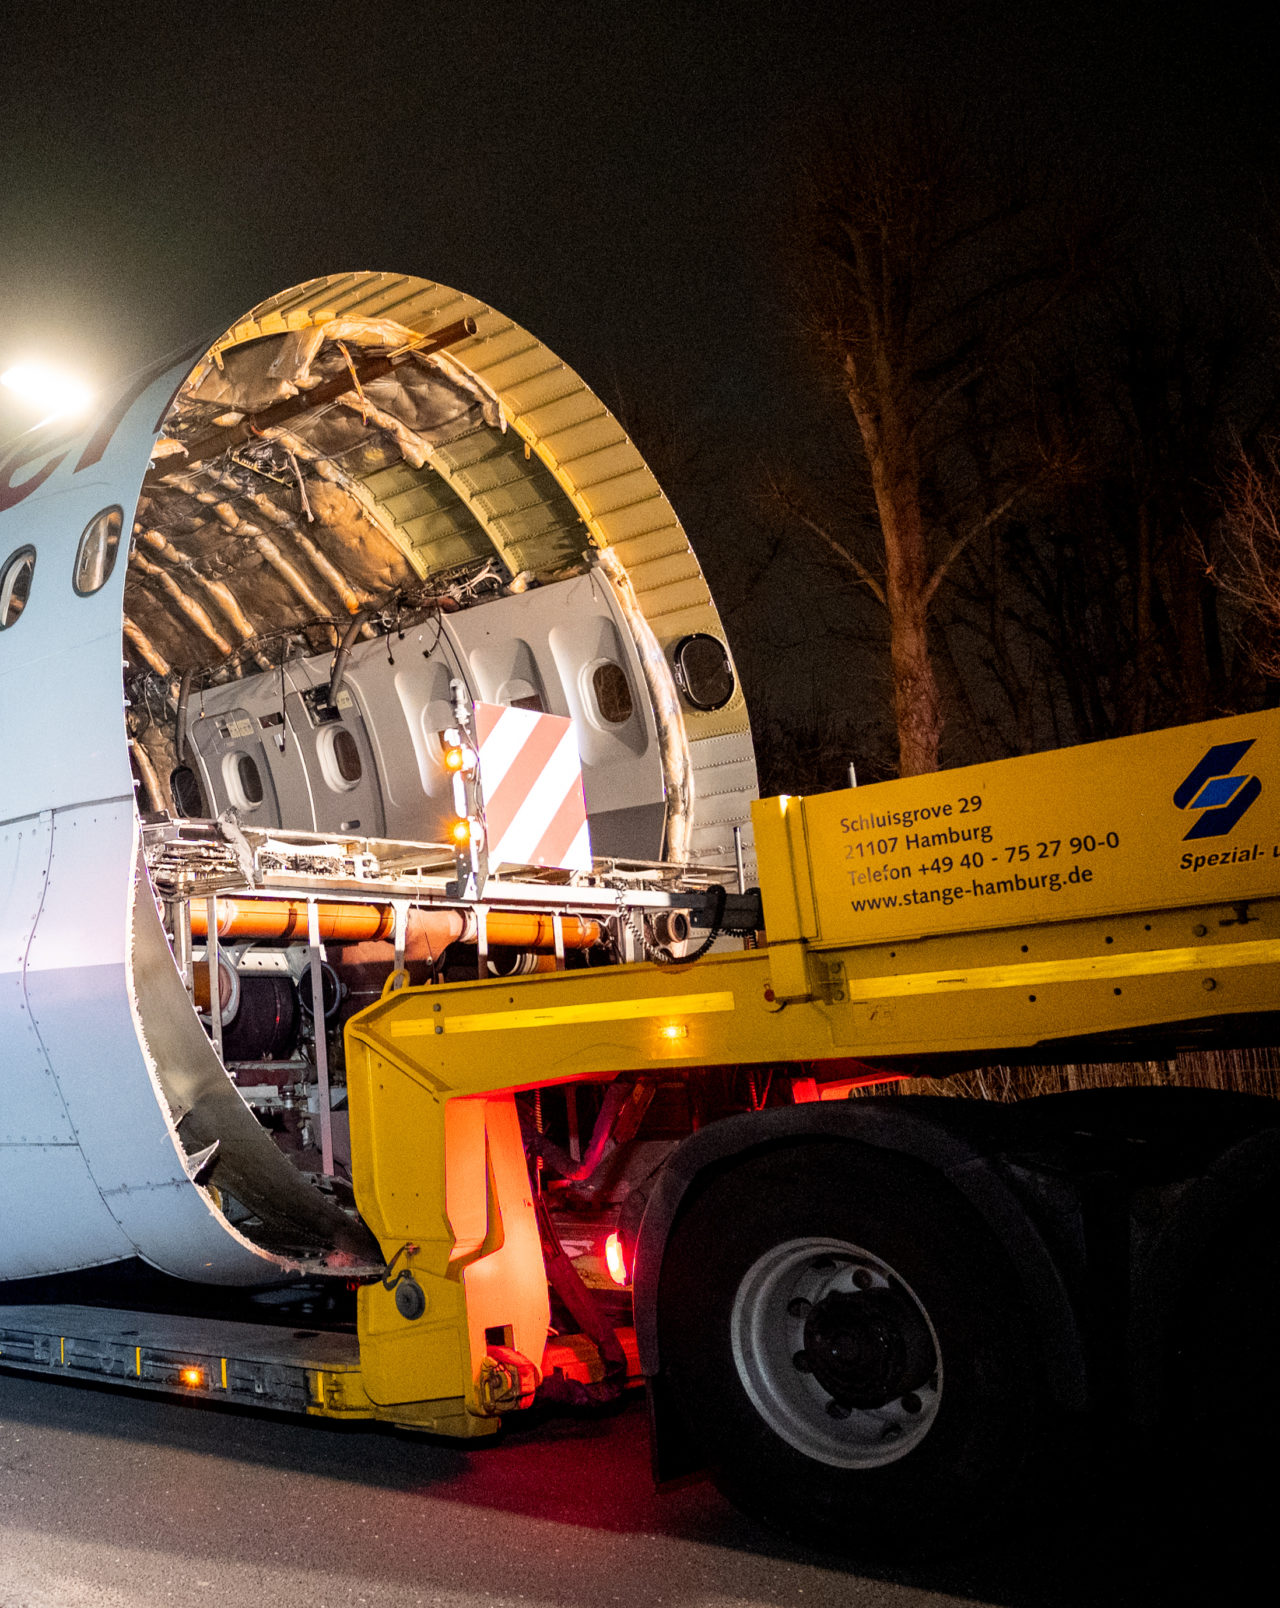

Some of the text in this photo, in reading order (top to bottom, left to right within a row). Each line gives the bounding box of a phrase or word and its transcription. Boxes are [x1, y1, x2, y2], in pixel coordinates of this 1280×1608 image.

[840, 795, 983, 834] Schluisgrove 29
[844, 825, 994, 860] 21107 Hamburg
[848, 863, 912, 887] Telefon
[918, 856, 954, 876] +49
[960, 851, 984, 869] 40
[1004, 844, 1030, 864] 75
[1036, 839, 1061, 859] 27
[1070, 831, 1120, 854] 90-0
[1180, 843, 1265, 873] Spezial-
[851, 865, 1094, 912] www.stange-hamburg.de
